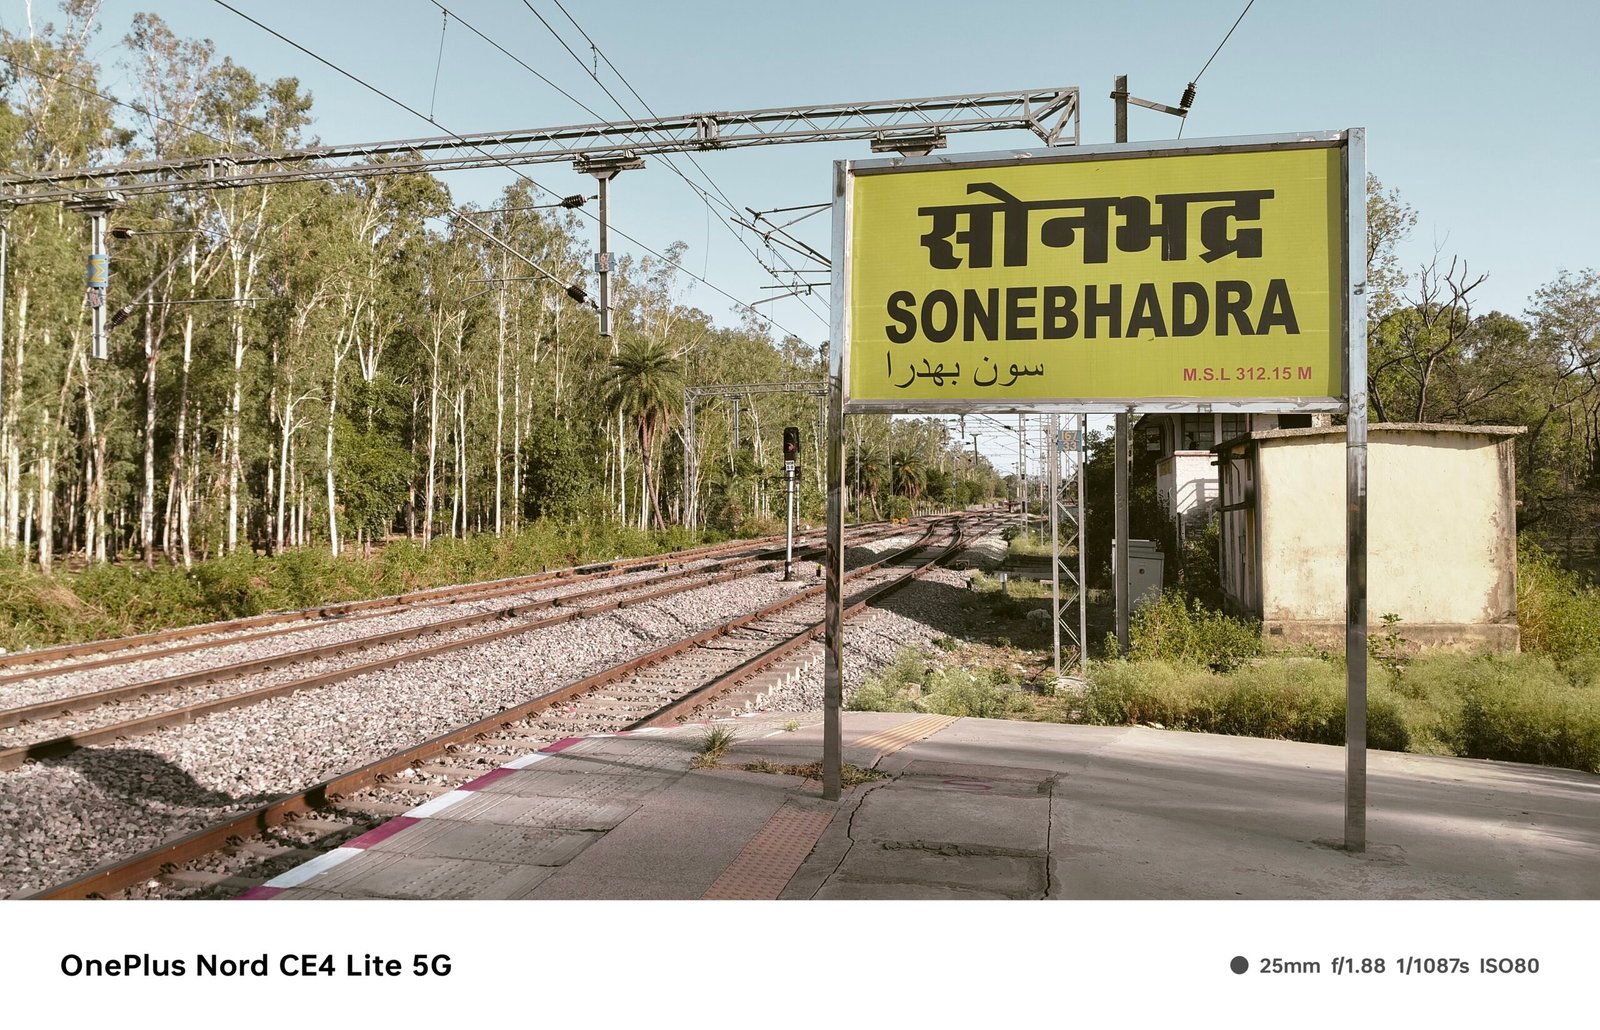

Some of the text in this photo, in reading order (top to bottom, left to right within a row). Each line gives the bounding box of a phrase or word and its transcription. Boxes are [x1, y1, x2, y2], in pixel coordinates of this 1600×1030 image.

[917, 182, 1275, 270] सोनभद्र
[885, 278, 1301, 344] SONEBHADRA
[886, 350, 1044, 389] سون بهدرا
[1182, 366, 1313, 382] M.S.L 312.15 M
[1063, 441, 1077, 451] 33
